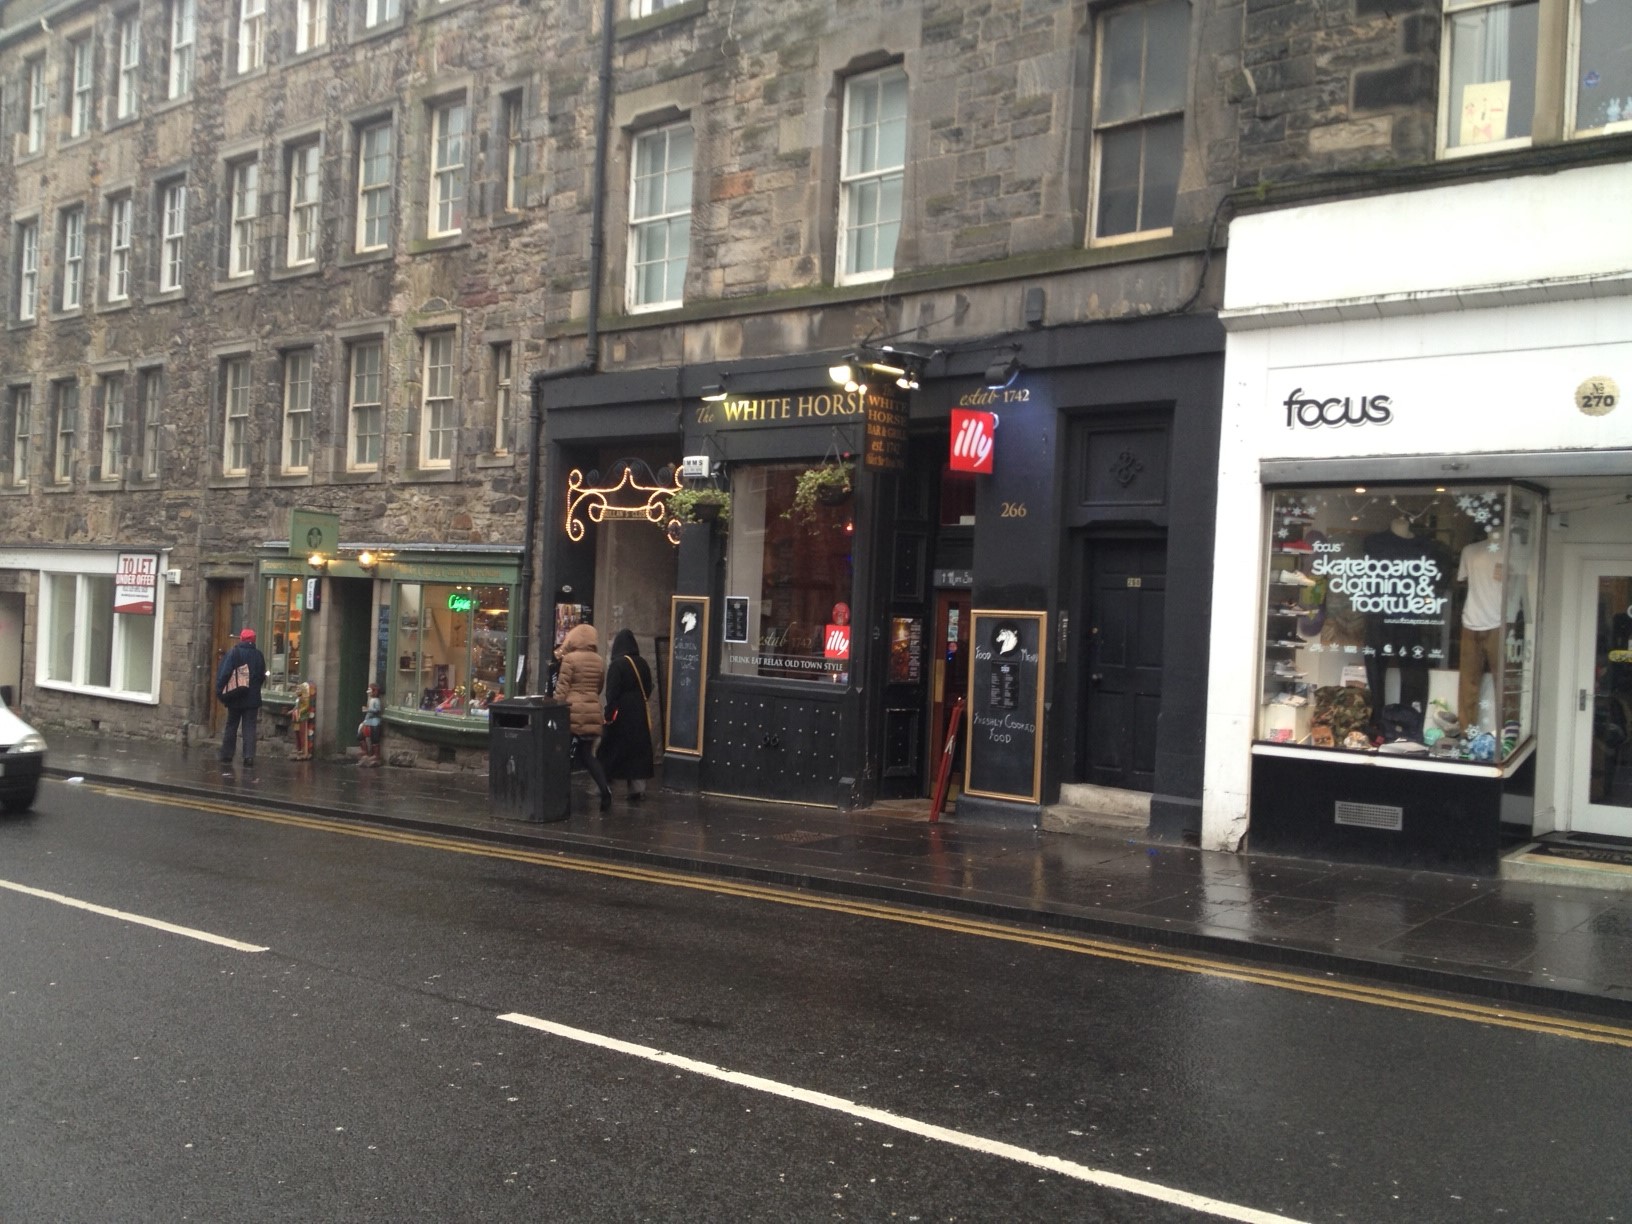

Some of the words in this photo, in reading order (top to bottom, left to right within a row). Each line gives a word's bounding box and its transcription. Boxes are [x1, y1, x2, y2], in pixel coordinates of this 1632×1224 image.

[867, 394, 908, 413] WHITE
[1003, 389, 1030, 403] 1742
[1582, 394, 1615, 408] 270
[695, 403, 715, 424] The
[723, 397, 791, 422] WHITE
[1283, 388, 1392, 428] focus
[868, 409, 907, 427] HORSE
[953, 418, 993, 468] illy
[1001, 502, 1027, 517] 266
[1312, 541, 1342, 553] focus
[123, 557, 134, 574] TO
[136, 557, 153, 574] LET
[1311, 554, 1442, 581] skateboards,
[115, 574, 136, 585] UNDER
[136, 575, 155, 586] OFFER
[1329, 573, 1415, 598] clothing
[1416, 575, 1435, 598] &
[1350, 593, 1448, 614] footwear
[826, 630, 849, 655] illy
[730, 655, 750, 664] DRINK
[751, 656, 762, 665] EAT
[763, 657, 783, 667] RELAX
[784, 659, 800, 668] OLD
[801, 661, 823, 670] TOWN
[824, 663, 843, 671] STYLE
[989, 728, 1011, 744] FOOD
